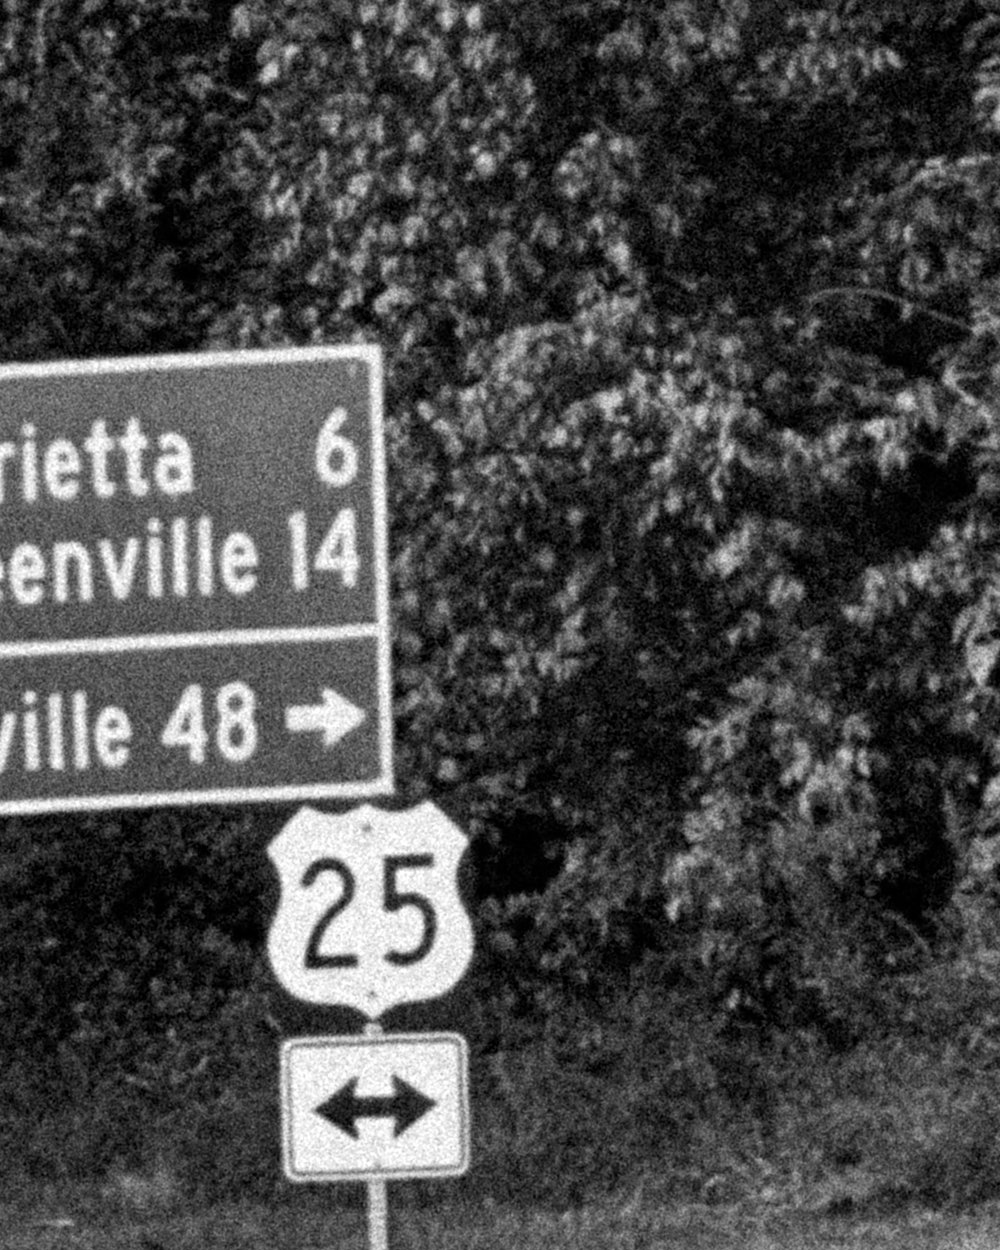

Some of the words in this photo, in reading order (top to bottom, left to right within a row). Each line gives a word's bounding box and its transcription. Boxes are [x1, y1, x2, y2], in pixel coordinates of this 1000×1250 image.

[313, 405, 360, 489] 6
[286, 506, 362, 592] 14
[160, 680, 259, 765] 48
[300, 852, 438, 971] 25
